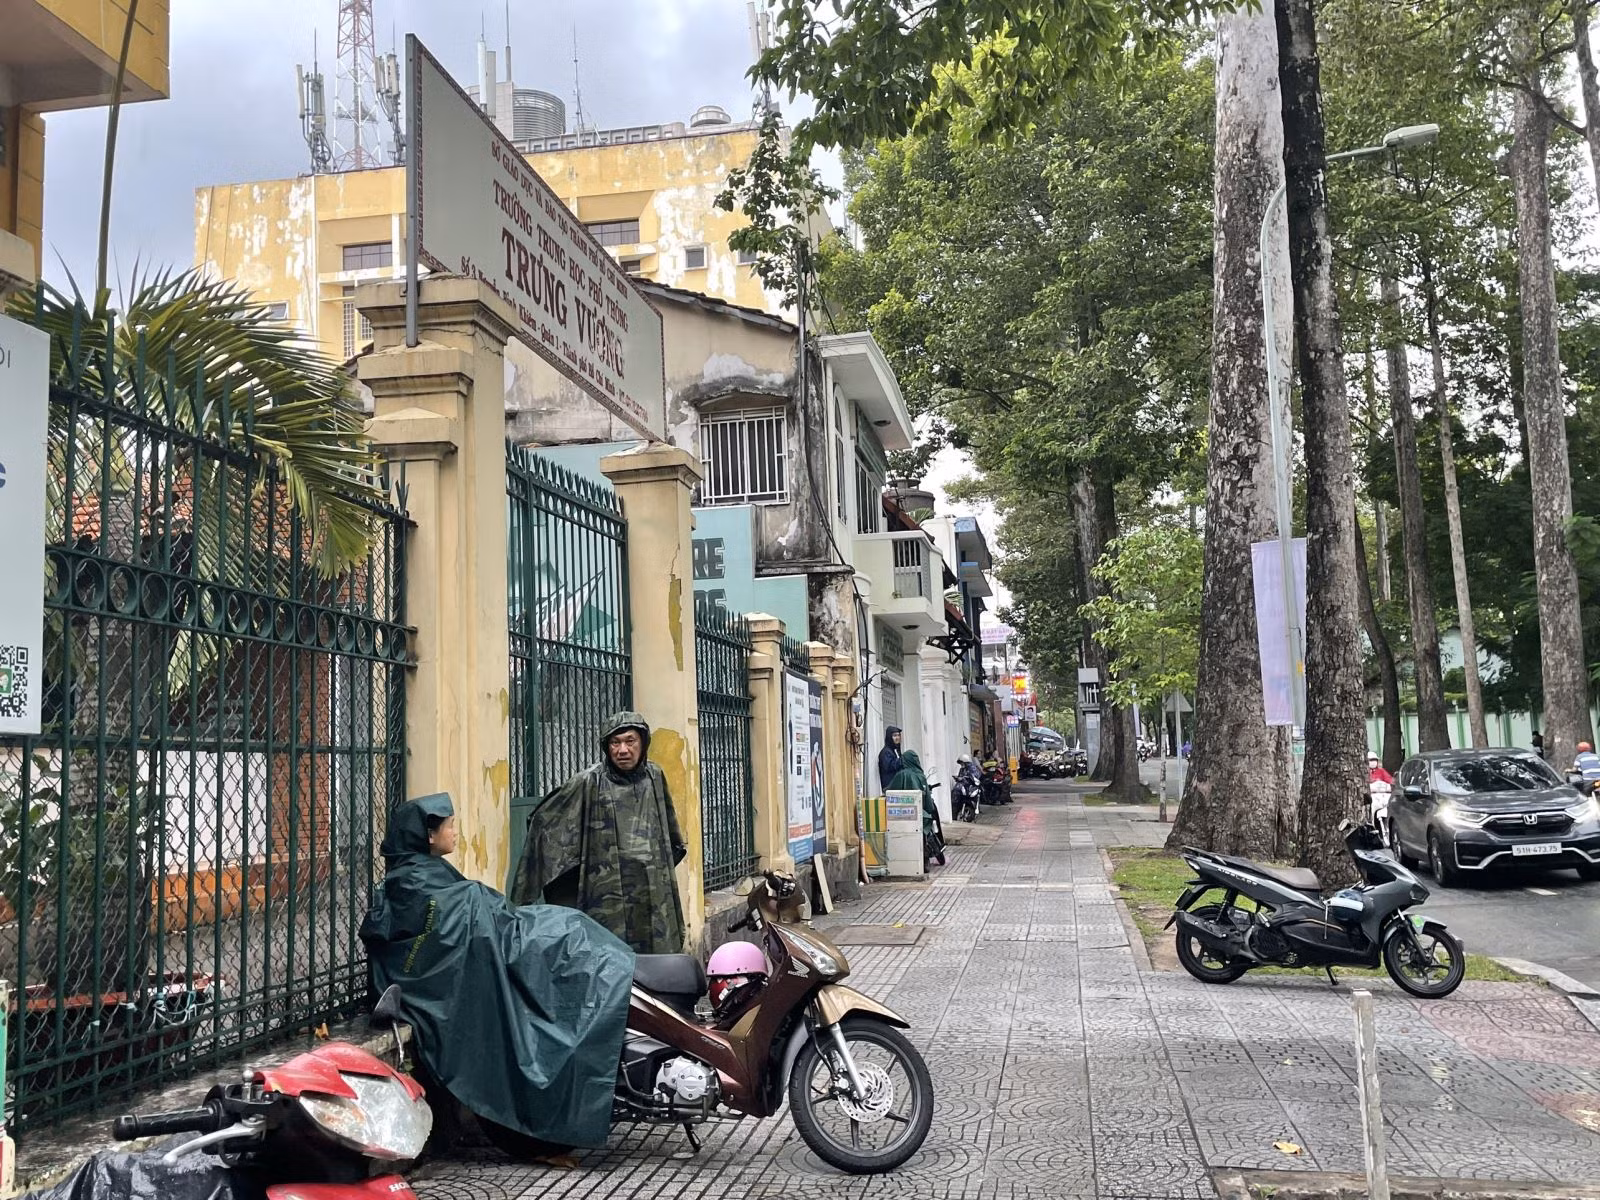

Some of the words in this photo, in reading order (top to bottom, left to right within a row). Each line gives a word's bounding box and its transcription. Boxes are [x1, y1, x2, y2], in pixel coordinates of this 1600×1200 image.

[502, 153, 518, 181] GIÁO
[521, 172, 533, 198] DỤC
[461, 255, 470, 276] Số
[493, 178, 532, 237] TRƯỜNG
[536, 223, 566, 272] TRUNG
[569, 256, 586, 290] HỌC
[605, 294, 628, 333] THÔNG
[501, 226, 567, 329] TRƯNG
[574, 295, 625, 380] VƯƠNG
[787, 970, 809, 979] HONDA
